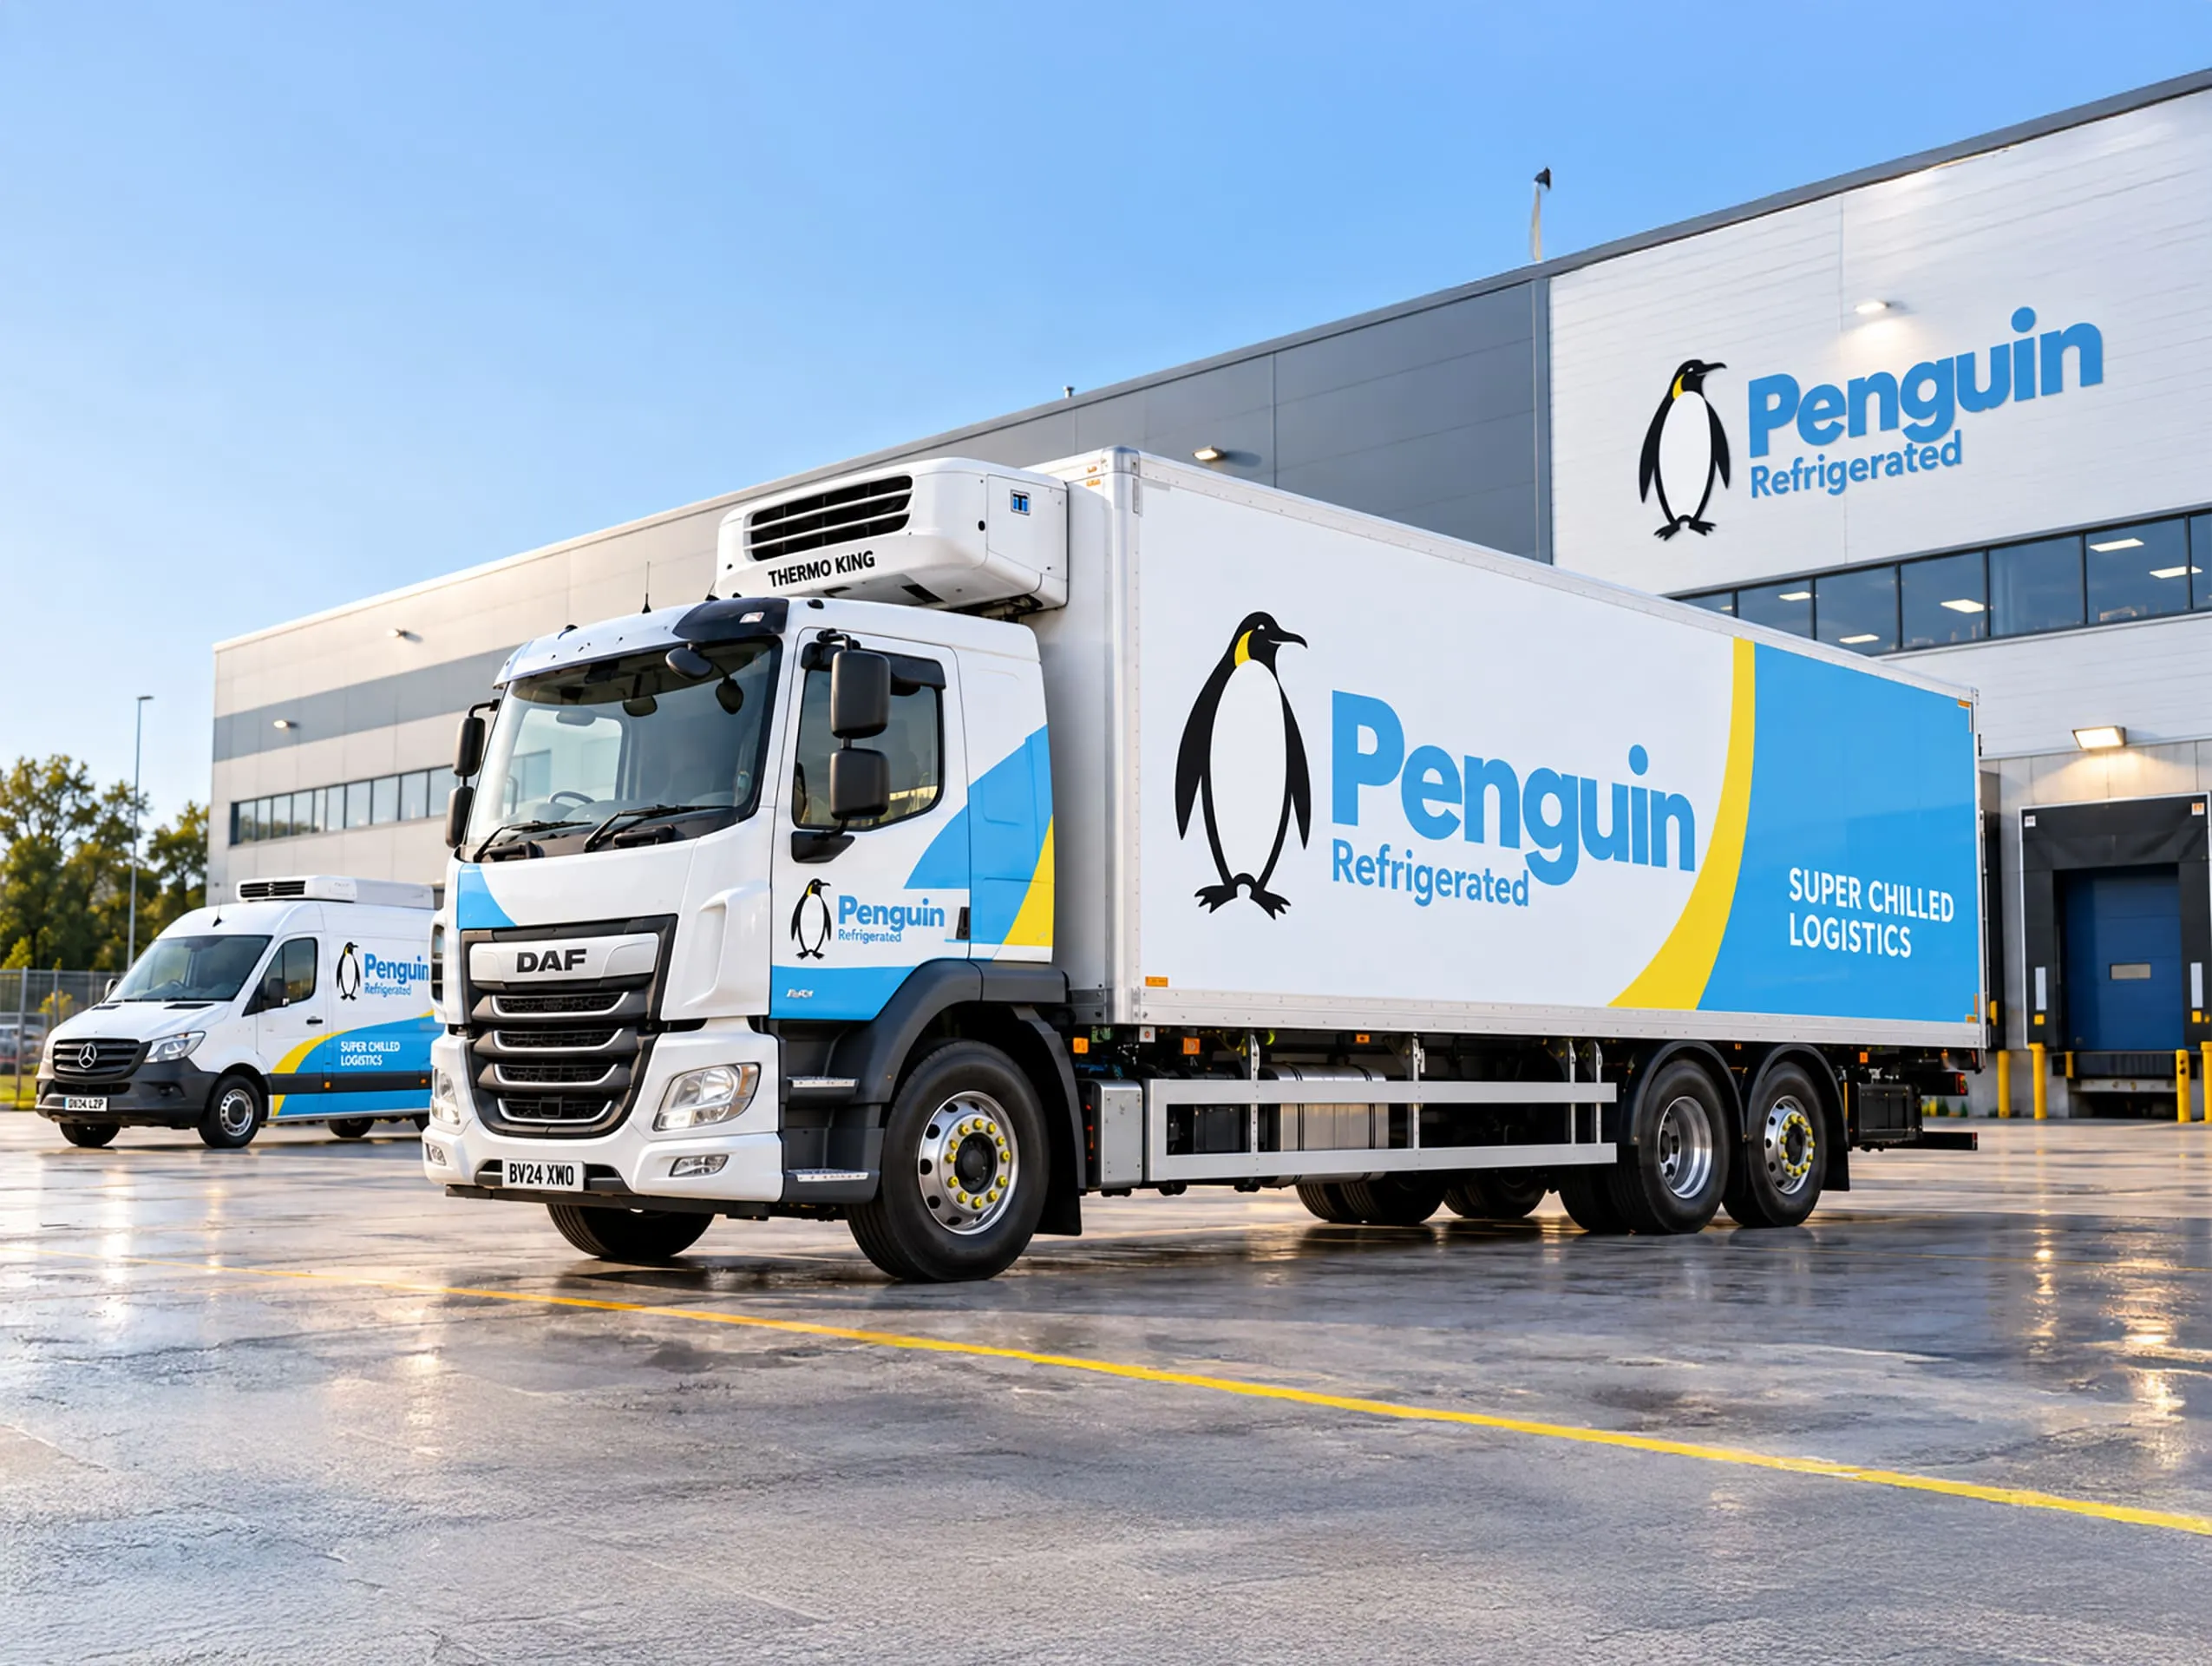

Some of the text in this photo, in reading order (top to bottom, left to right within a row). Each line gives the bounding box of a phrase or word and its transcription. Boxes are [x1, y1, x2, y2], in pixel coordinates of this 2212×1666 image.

[1748, 305, 2104, 459] Penguin
[1750, 430, 1963, 499] Refrigerated
[768, 550, 876, 588] THERMO KING
[1331, 690, 1696, 887] Penguin
[1332, 838, 1530, 908] Refrigerated
[838, 895, 946, 933] Penguin
[1788, 867, 1955, 923] SUPER CHILLED
[837, 928, 903, 945] Refrigerated
[1789, 912, 1913, 959] LOGISTICS
[363, 952, 429, 985] Penguin
[515, 948, 587, 974] DAF
[340, 1040, 401, 1053] SUPER CHILLED
[340, 1054, 383, 1066] LOGISTICS
[509, 1163, 575, 1186] BV24 XWO
